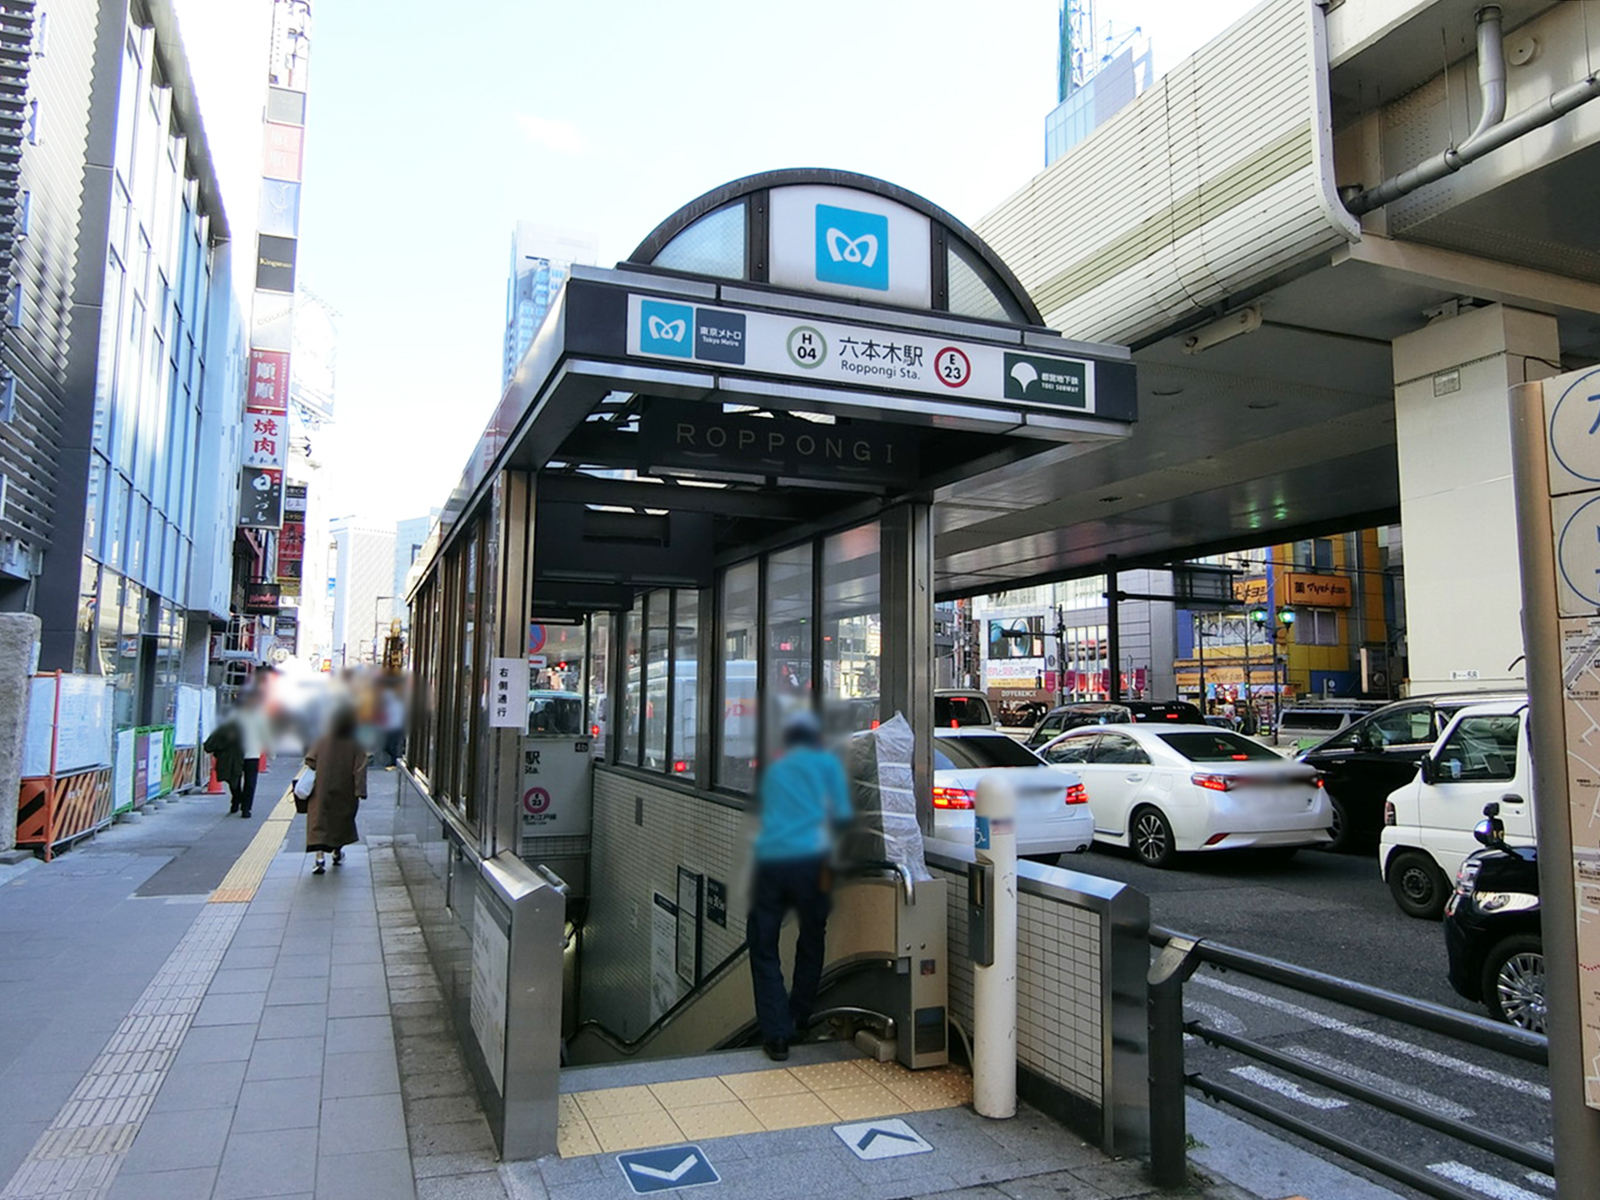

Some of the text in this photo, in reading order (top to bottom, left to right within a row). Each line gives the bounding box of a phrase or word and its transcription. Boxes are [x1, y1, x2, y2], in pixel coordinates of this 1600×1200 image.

[700, 326, 742, 340] 東京メトロ
[802, 333, 812, 346] H
[702, 336, 740, 347] Tokyo Metro
[797, 346, 817, 360] 04
[839, 336, 923, 368] 六本木駅
[949, 353, 957, 365] E
[841, 360, 921, 381] Roppongi Sta.
[944, 366, 962, 380] 23
[1041, 372, 1079, 386] 都営地下鉄
[1041, 382, 1079, 393] TOEI SUBWAY
[253, 418, 278, 456] 焼肉
[676, 423, 893, 464] ROPPONGI
[497, 667, 509, 718] 右側通行
[1001, 689, 1037, 698] DIFFERENCE
[532, 799, 542, 807] 23
